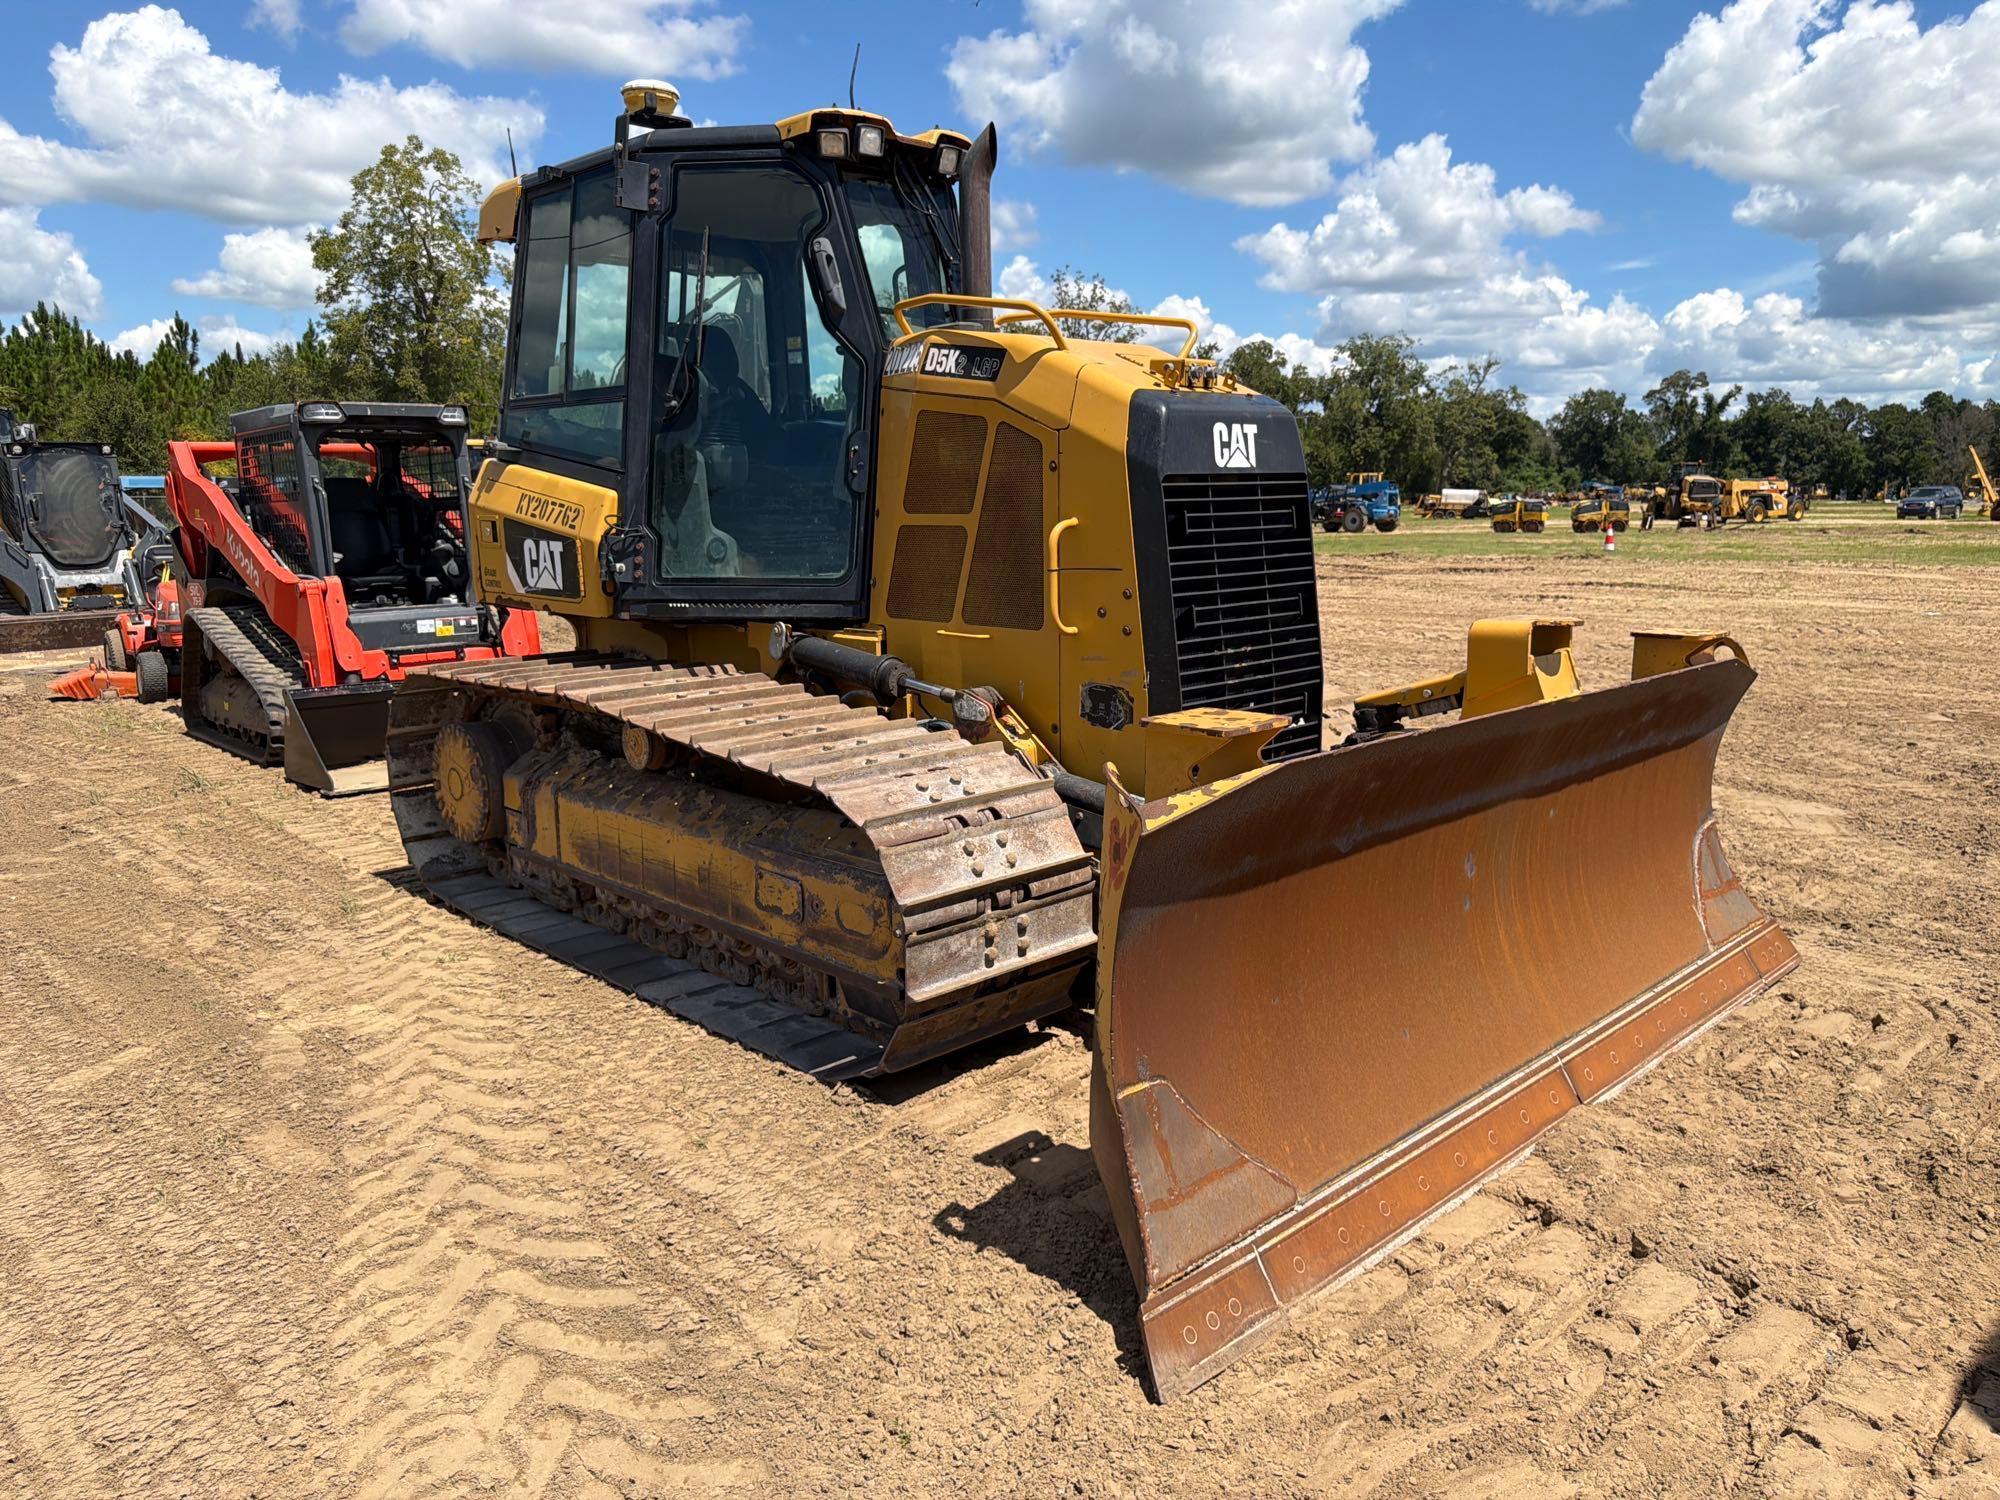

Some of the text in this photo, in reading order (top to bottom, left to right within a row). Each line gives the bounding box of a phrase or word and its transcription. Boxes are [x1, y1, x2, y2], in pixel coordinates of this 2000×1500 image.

[971, 357, 1000, 378] LGP
[1212, 421, 1258, 468] CAT
[515, 492, 581, 530] KY207762
[226, 528, 260, 588] Kubota
[523, 538, 564, 591] CAT
